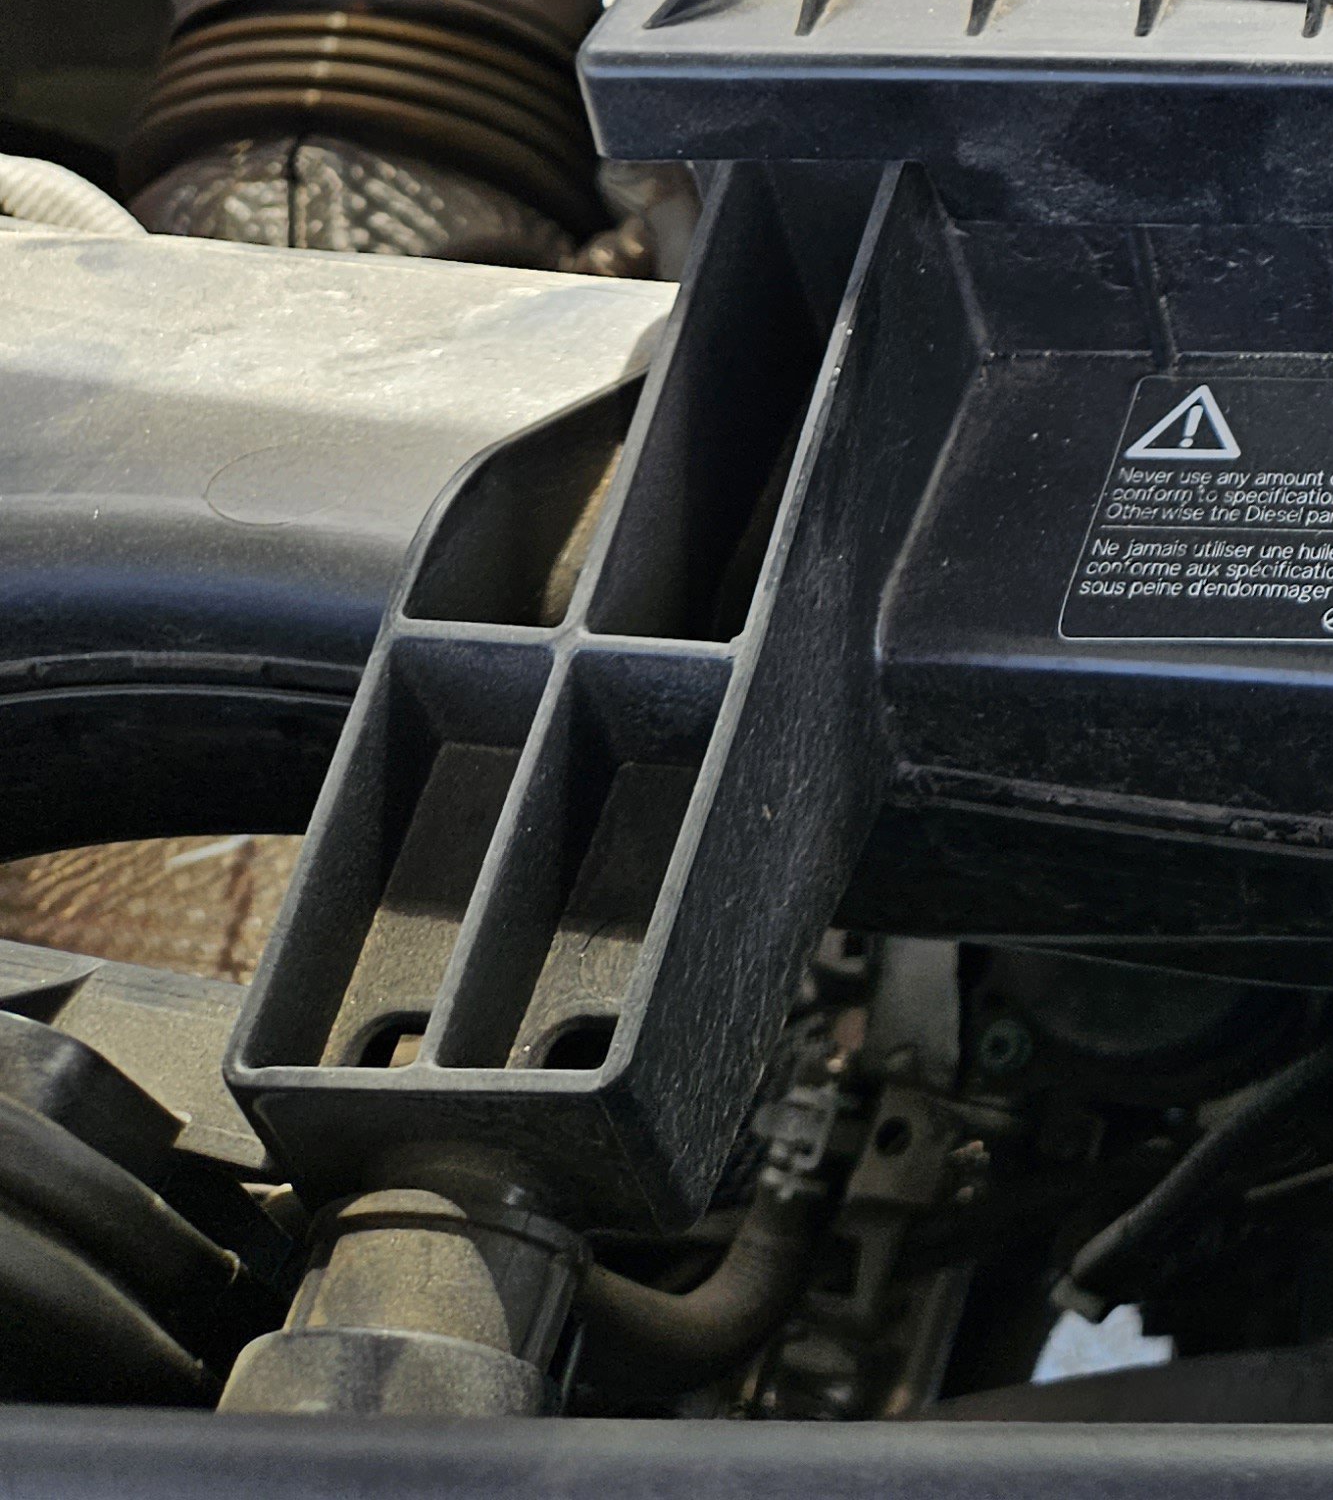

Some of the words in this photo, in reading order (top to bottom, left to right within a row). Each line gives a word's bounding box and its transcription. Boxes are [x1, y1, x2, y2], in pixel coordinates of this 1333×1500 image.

[1119, 467, 1174, 483] Never
[1180, 472, 1212, 485] use
[1216, 472, 1251, 488] any
[1255, 471, 1323, 486] amount
[1112, 485, 1193, 502] conform
[1244, 505, 1303, 522] Diesel
[1091, 539, 1120, 556] Ne
[1122, 539, 1187, 559] jamais
[1193, 540, 1254, 558] utiliser
[1260, 545, 1294, 559] une
[1086, 559, 1181, 576] conforme
[1186, 562, 1221, 577] aux
[1079, 580, 1126, 596] sous
[1128, 578, 1183, 599] peine
[1188, 578, 1332, 602] d'endommager
